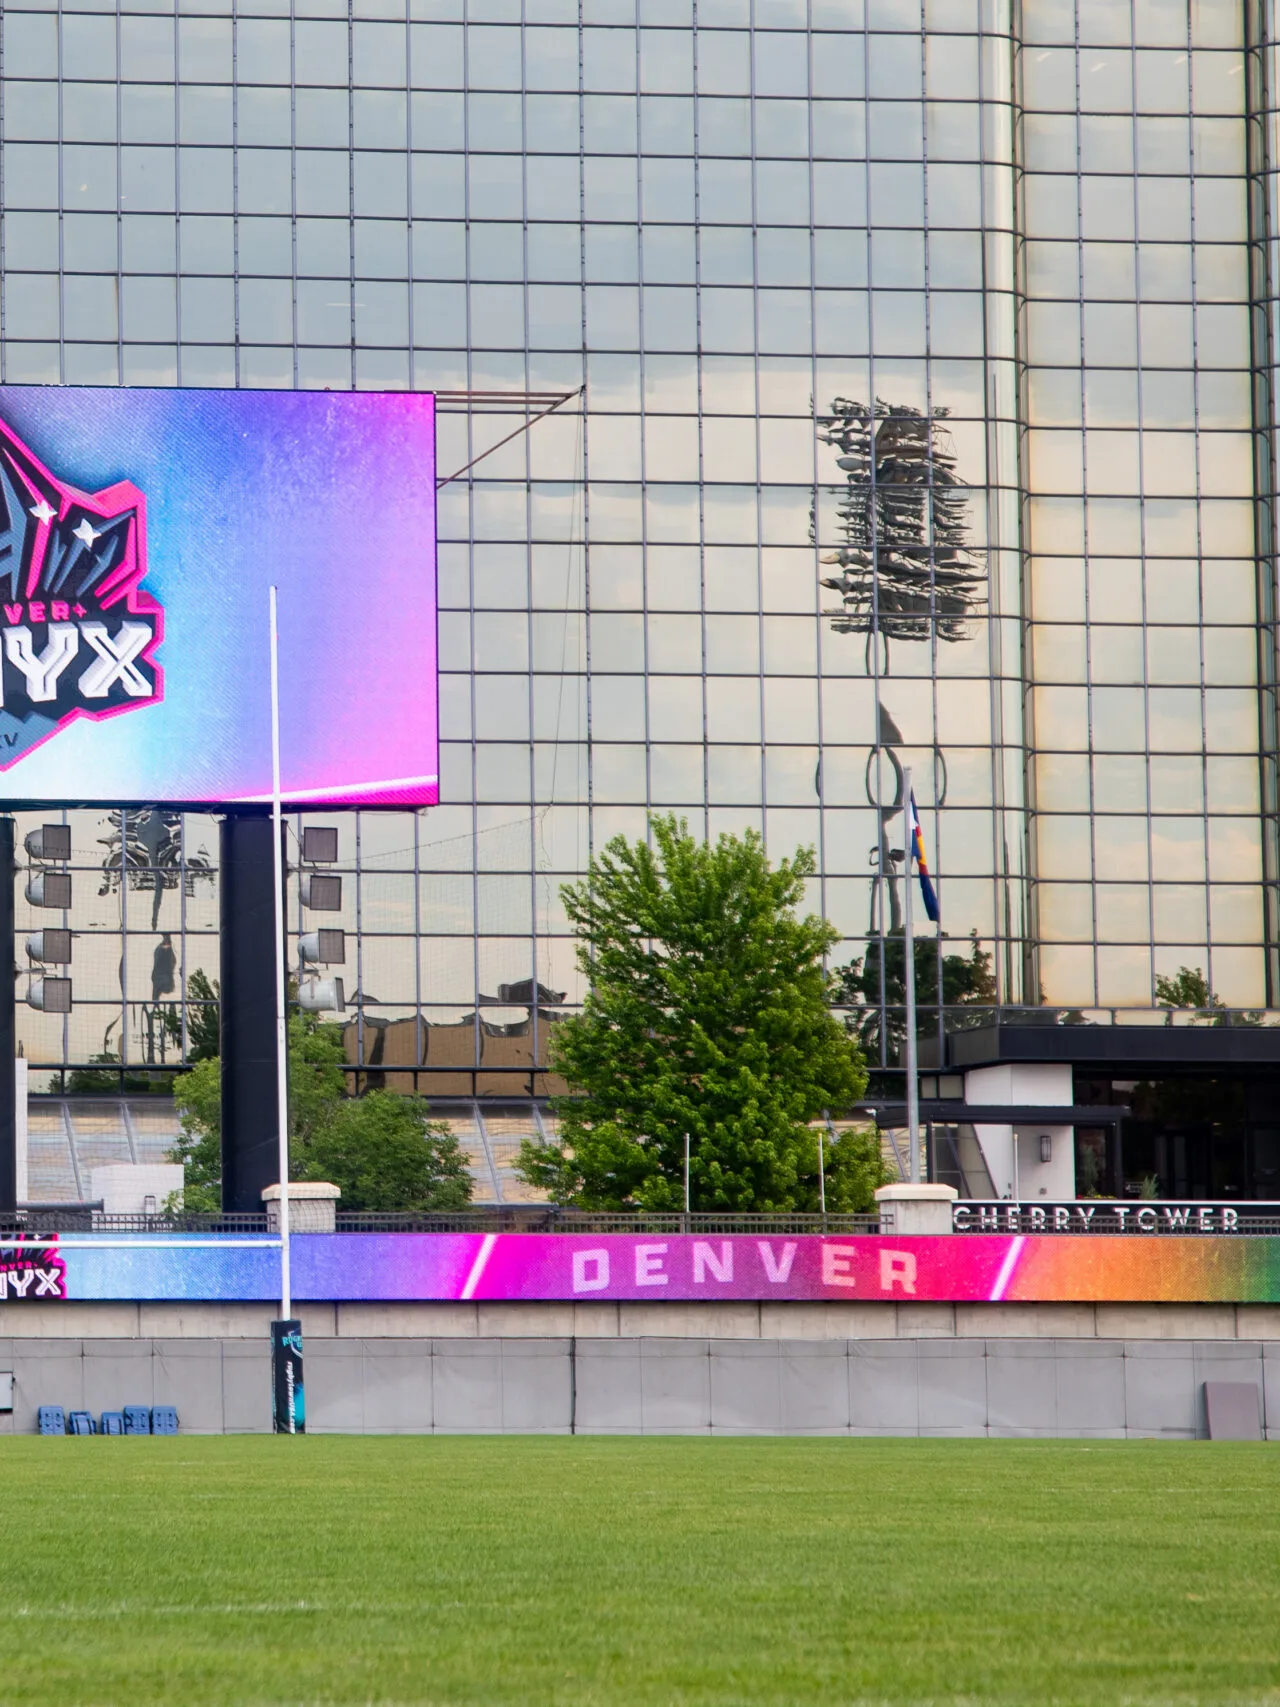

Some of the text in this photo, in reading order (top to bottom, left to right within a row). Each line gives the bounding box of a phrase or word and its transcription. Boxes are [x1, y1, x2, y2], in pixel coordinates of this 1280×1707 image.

[953, 1206, 1238, 1231] CHERRY TOWER
[572, 1240, 917, 1294] DENVER
